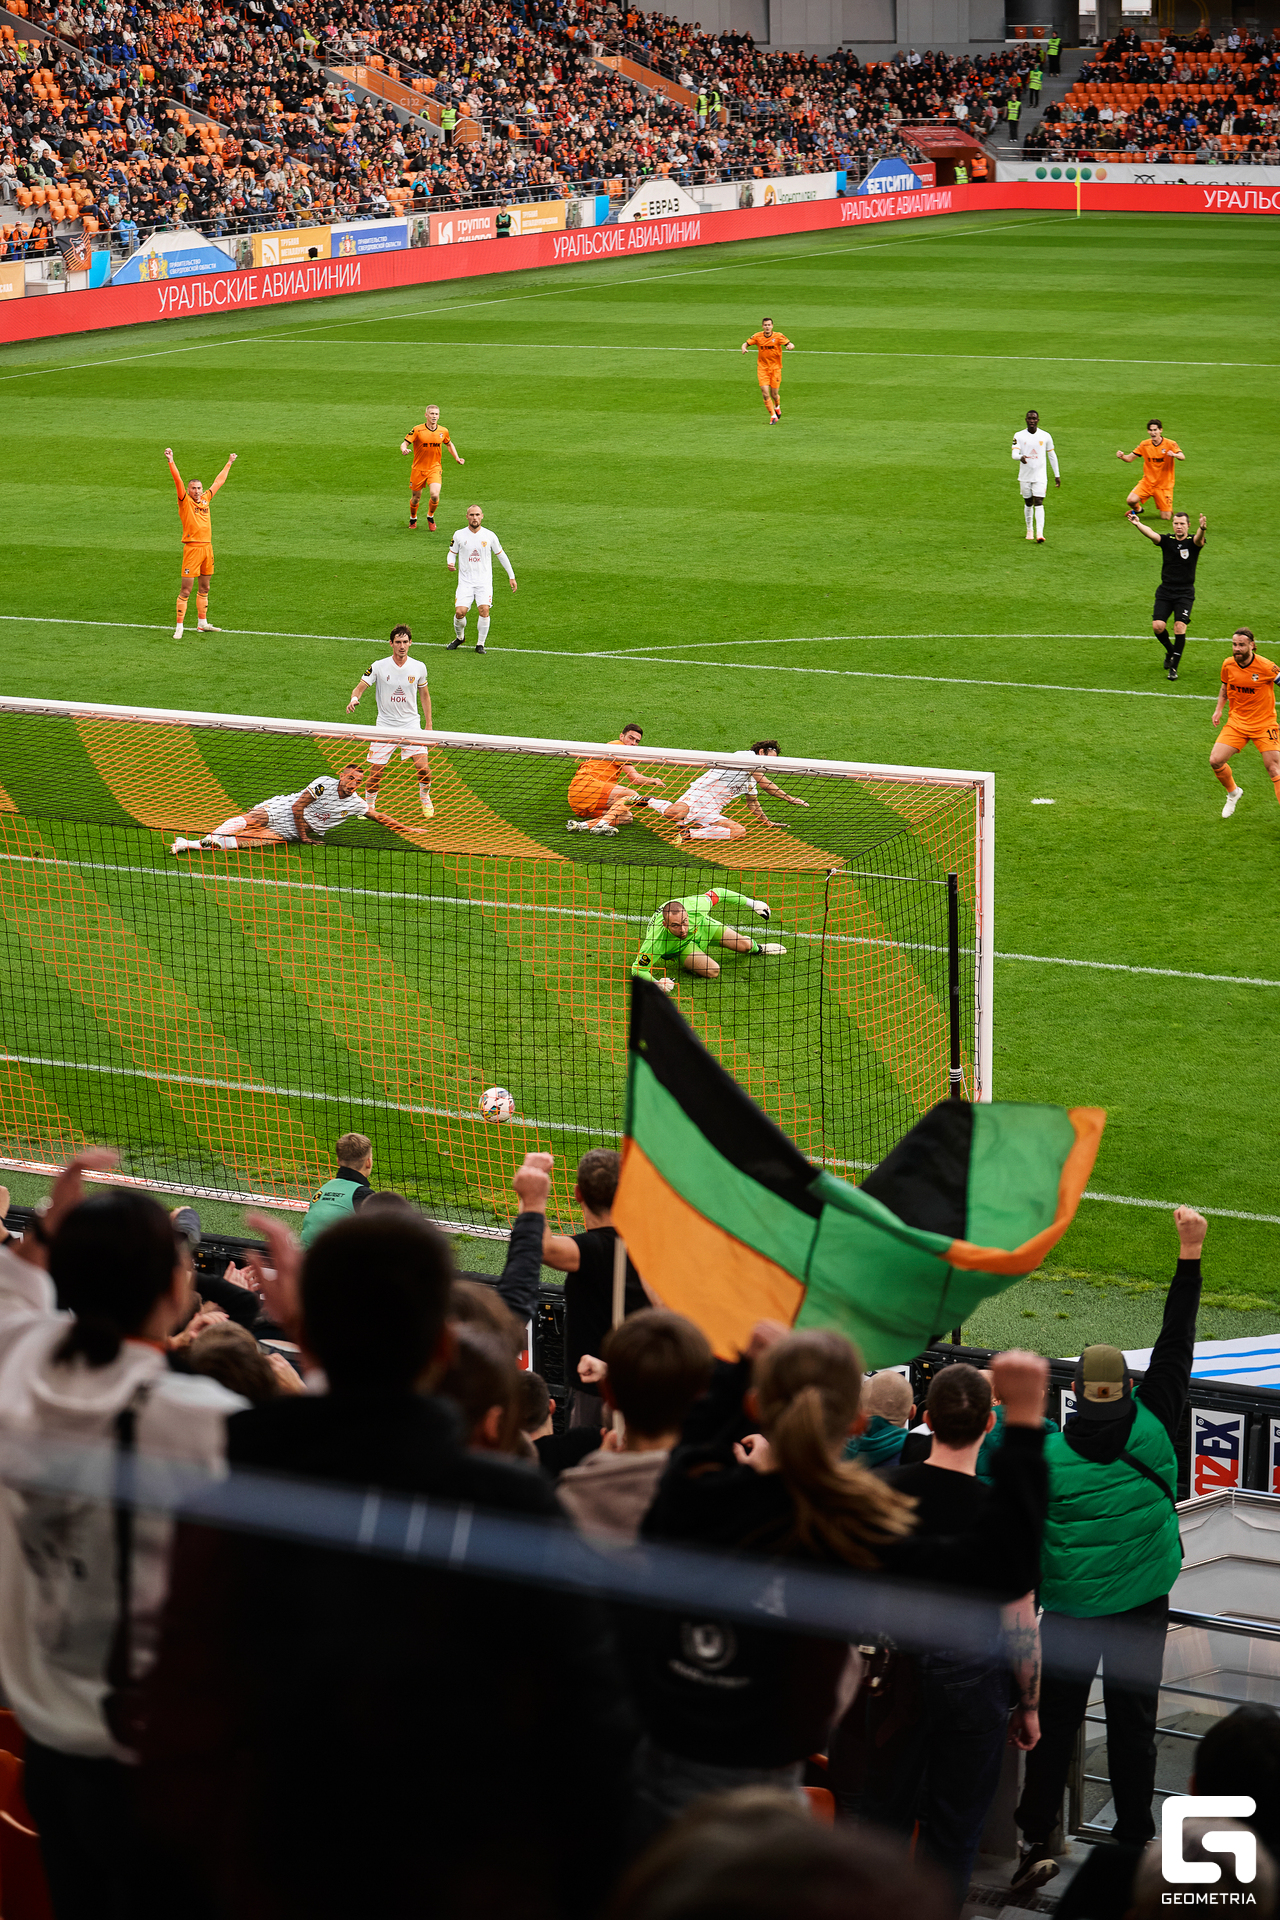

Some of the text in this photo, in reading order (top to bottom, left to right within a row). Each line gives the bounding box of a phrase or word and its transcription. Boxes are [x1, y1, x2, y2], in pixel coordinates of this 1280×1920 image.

[649, 198, 680, 216] ЕВРАЗ
[840, 190, 952, 222] УРАЛЬСКИЕ АВИАЛИНИИ
[553, 220, 700, 259] УРАЛЬСКИЕ АВИАЛИНИИ
[157, 262, 361, 313] УРАЛЬСКИЕ АВИАЛИНИИ
